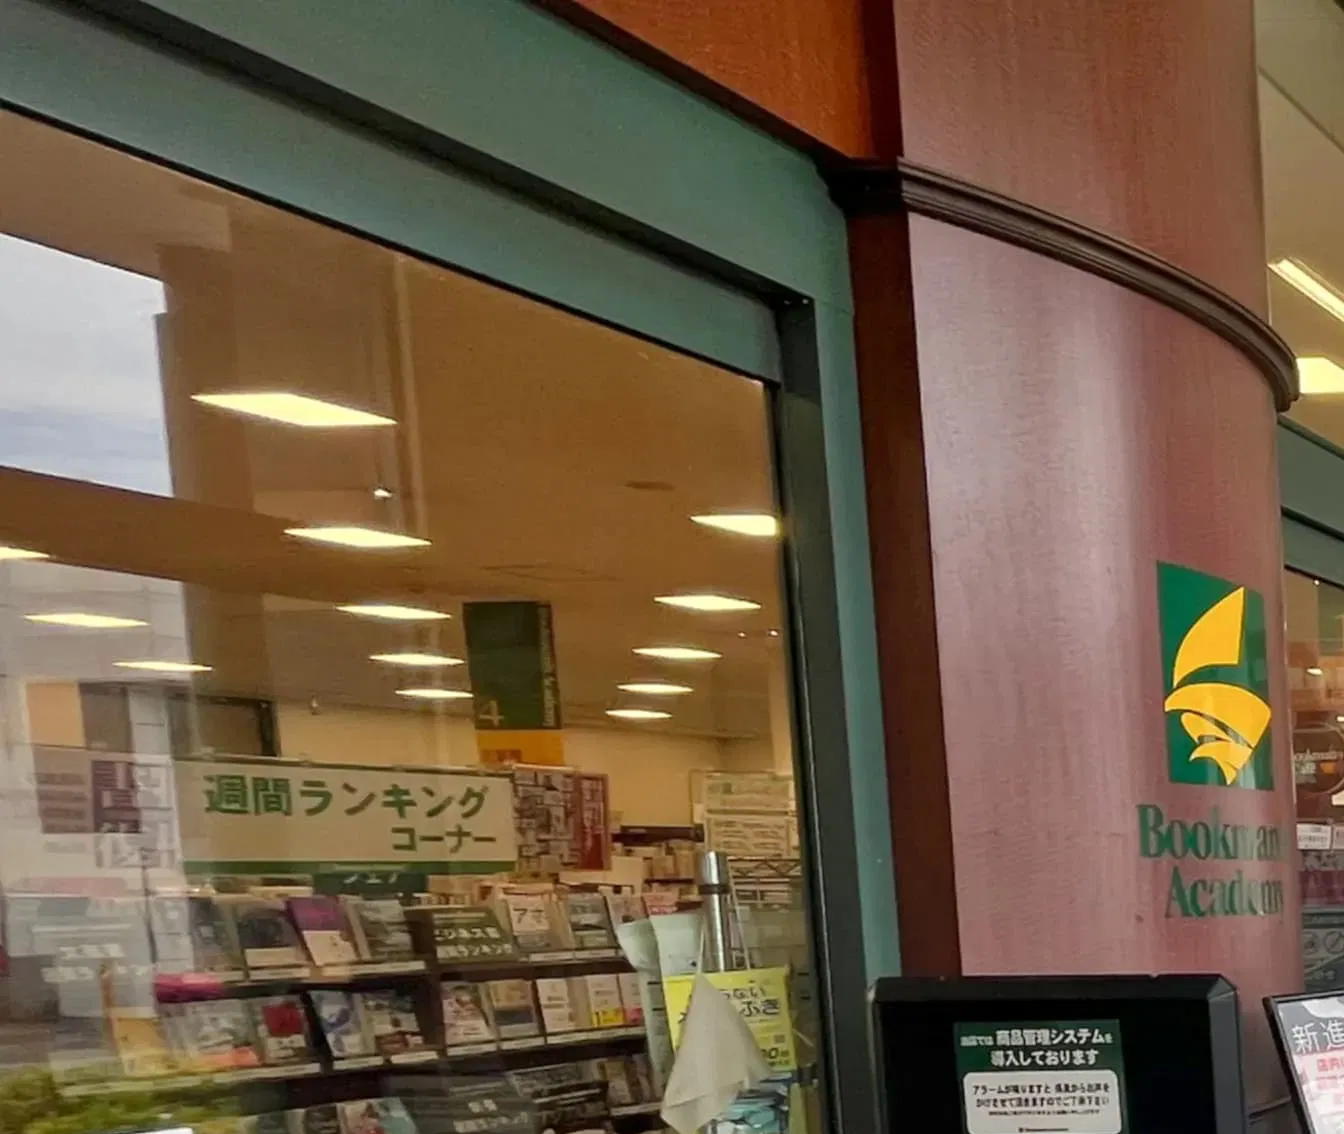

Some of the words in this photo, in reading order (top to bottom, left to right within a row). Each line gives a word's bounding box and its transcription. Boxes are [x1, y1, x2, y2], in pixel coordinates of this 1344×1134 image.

[203, 774, 489, 819] 週間ランキング
[391, 825, 497, 852] コーナー
